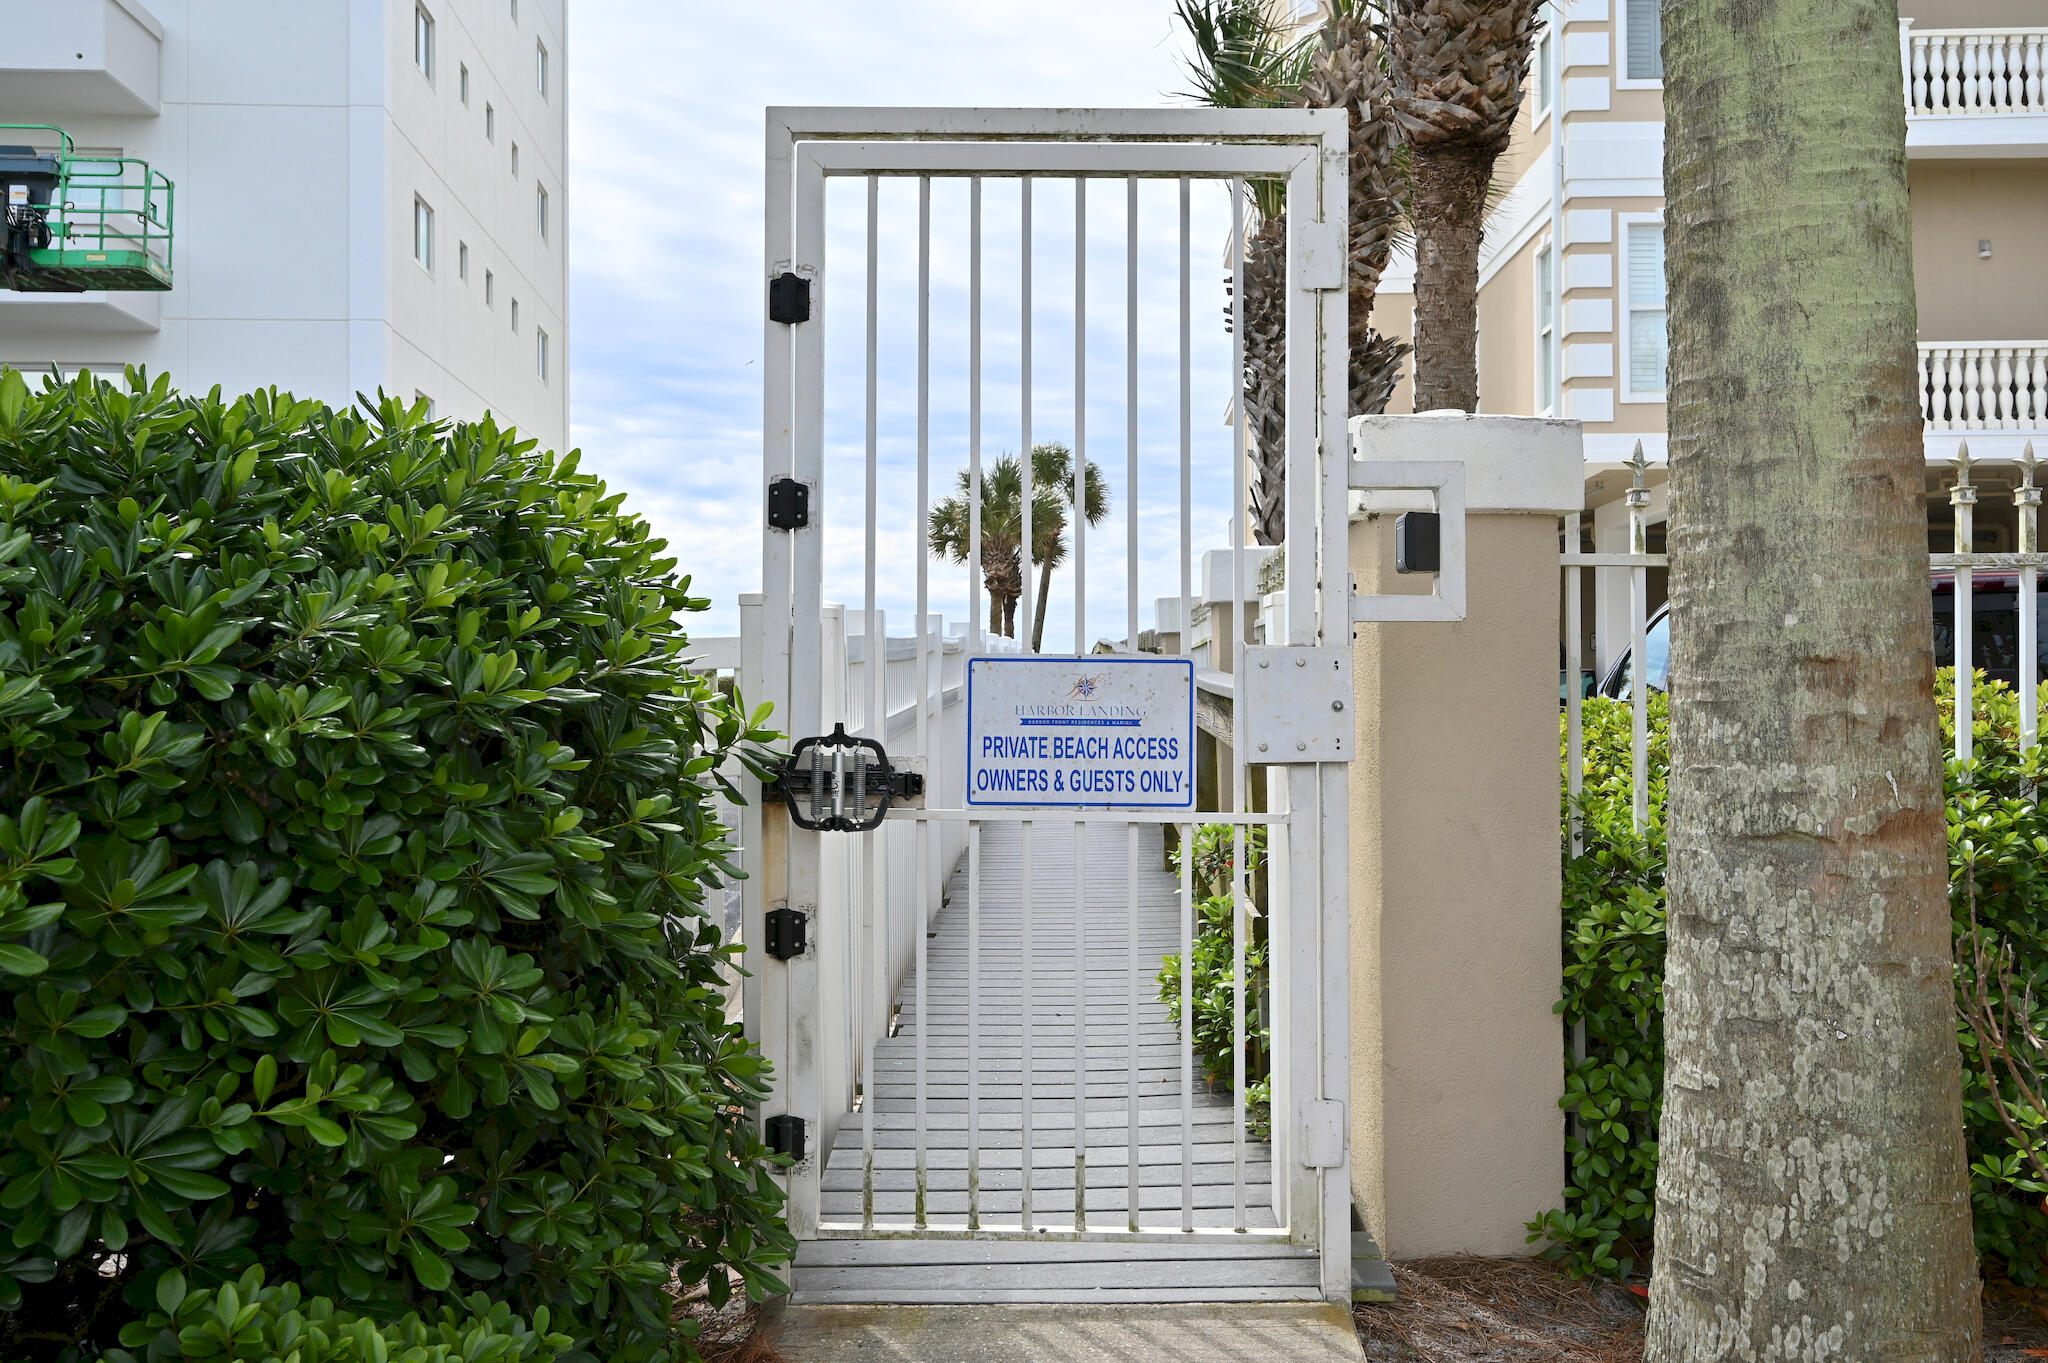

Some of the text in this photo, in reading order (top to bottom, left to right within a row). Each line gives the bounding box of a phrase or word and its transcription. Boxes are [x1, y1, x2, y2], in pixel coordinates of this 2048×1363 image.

[1015, 705, 1146, 717] HARBOR LANDING
[983, 736, 1178, 760] PRIVATE BEACH ACCESS
[977, 768, 1183, 793] OWNERS & GUESTS ONLY
